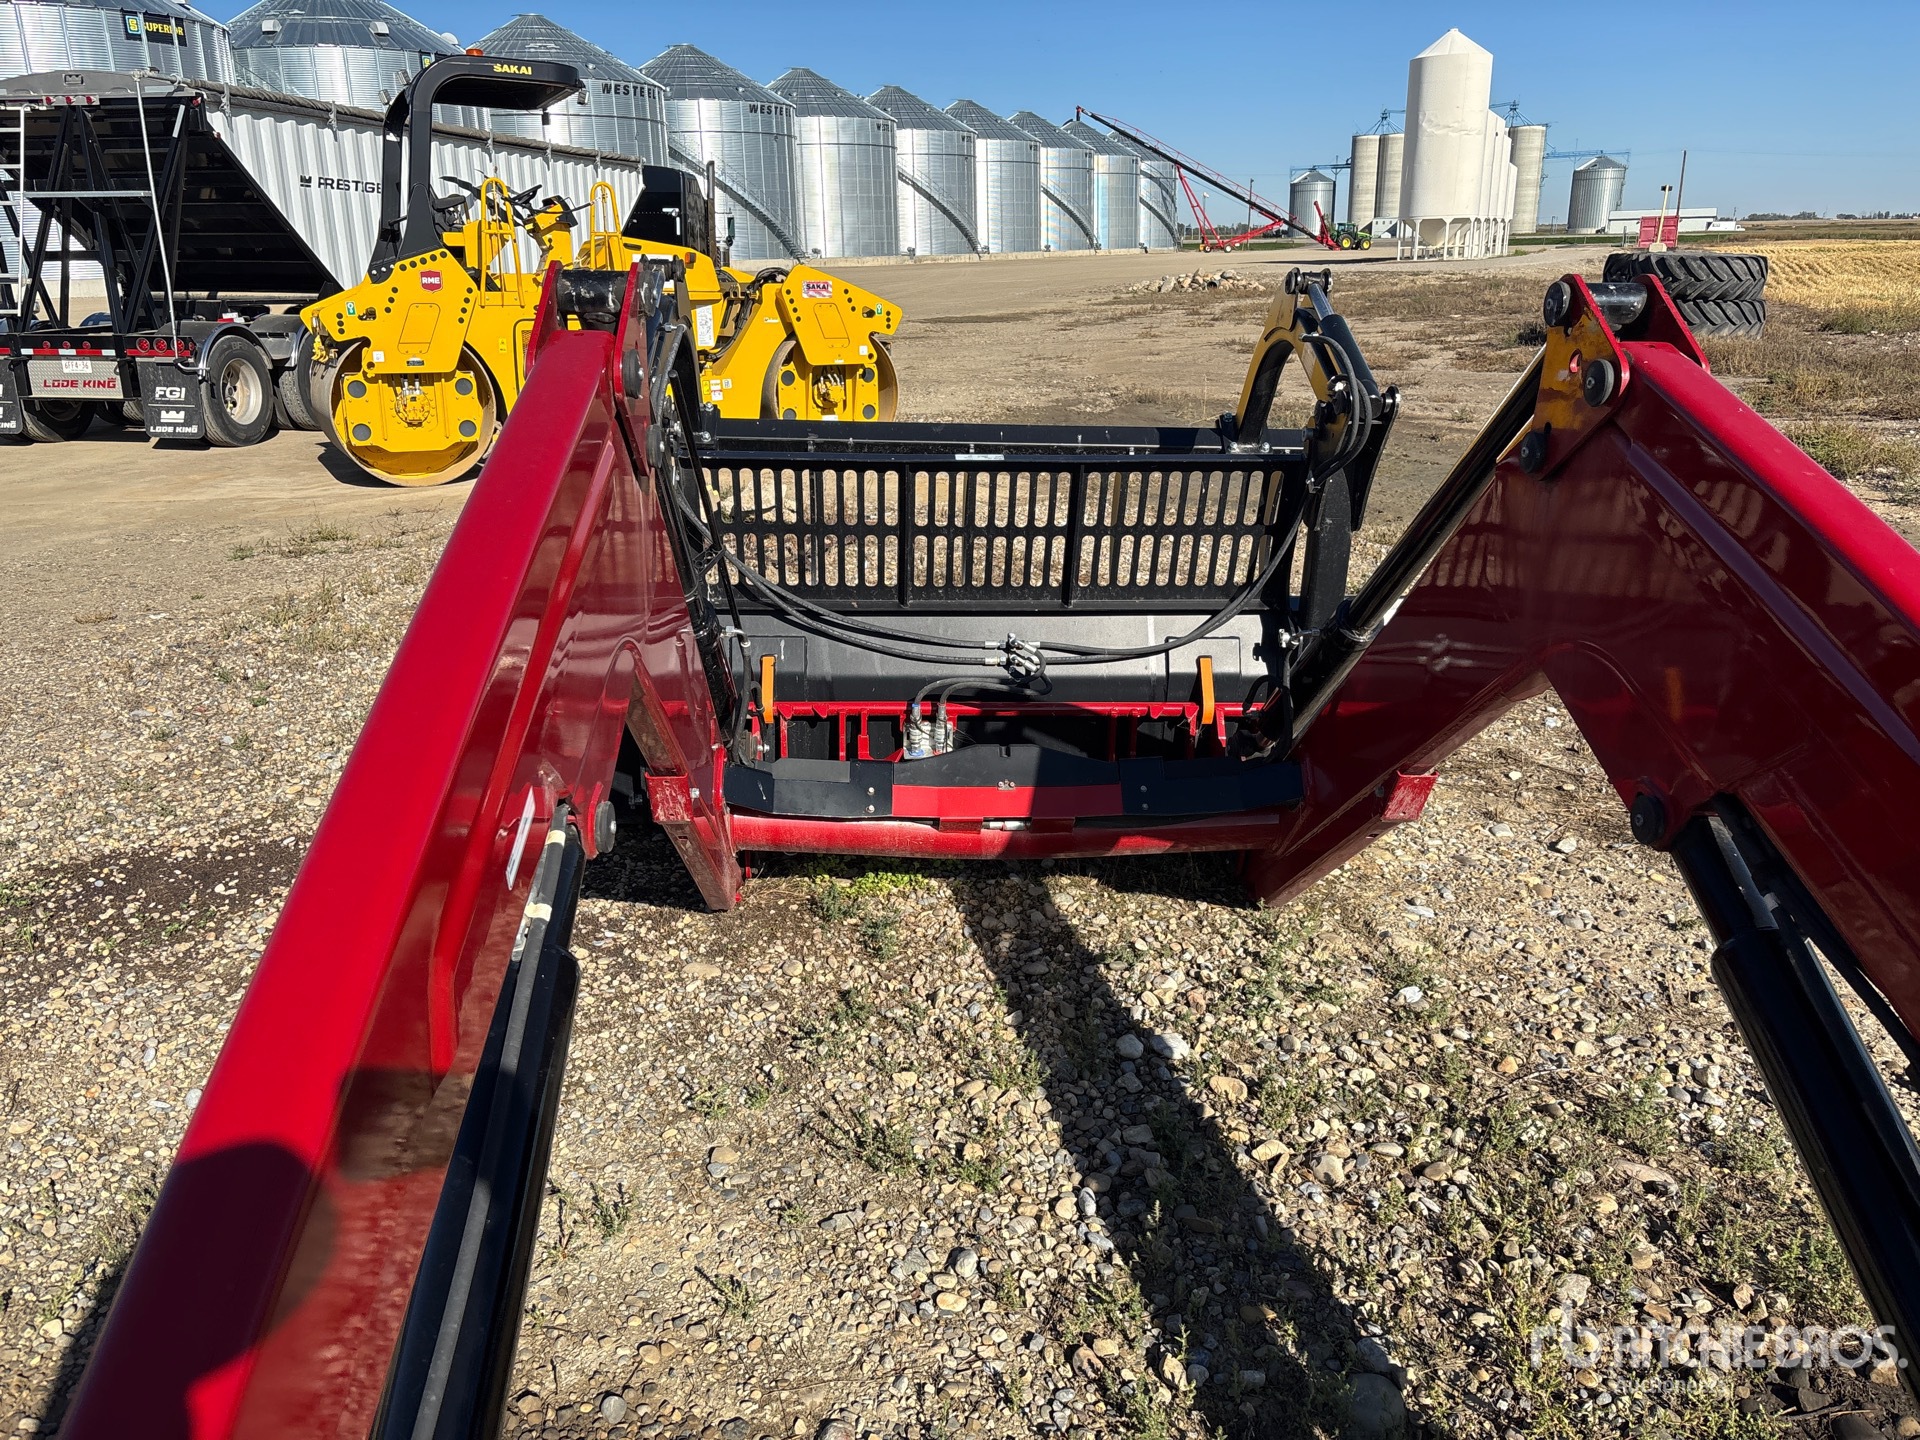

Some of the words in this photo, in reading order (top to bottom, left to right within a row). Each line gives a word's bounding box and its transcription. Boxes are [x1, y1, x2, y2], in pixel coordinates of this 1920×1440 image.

[493, 64, 532, 75] SAKAI
[601, 82, 657, 100] WESTEEL
[43, 379, 79, 388] LODE
[83, 378, 117, 388] KING
[155, 386, 186, 399] FGI
[175, 425, 199, 433] KING
